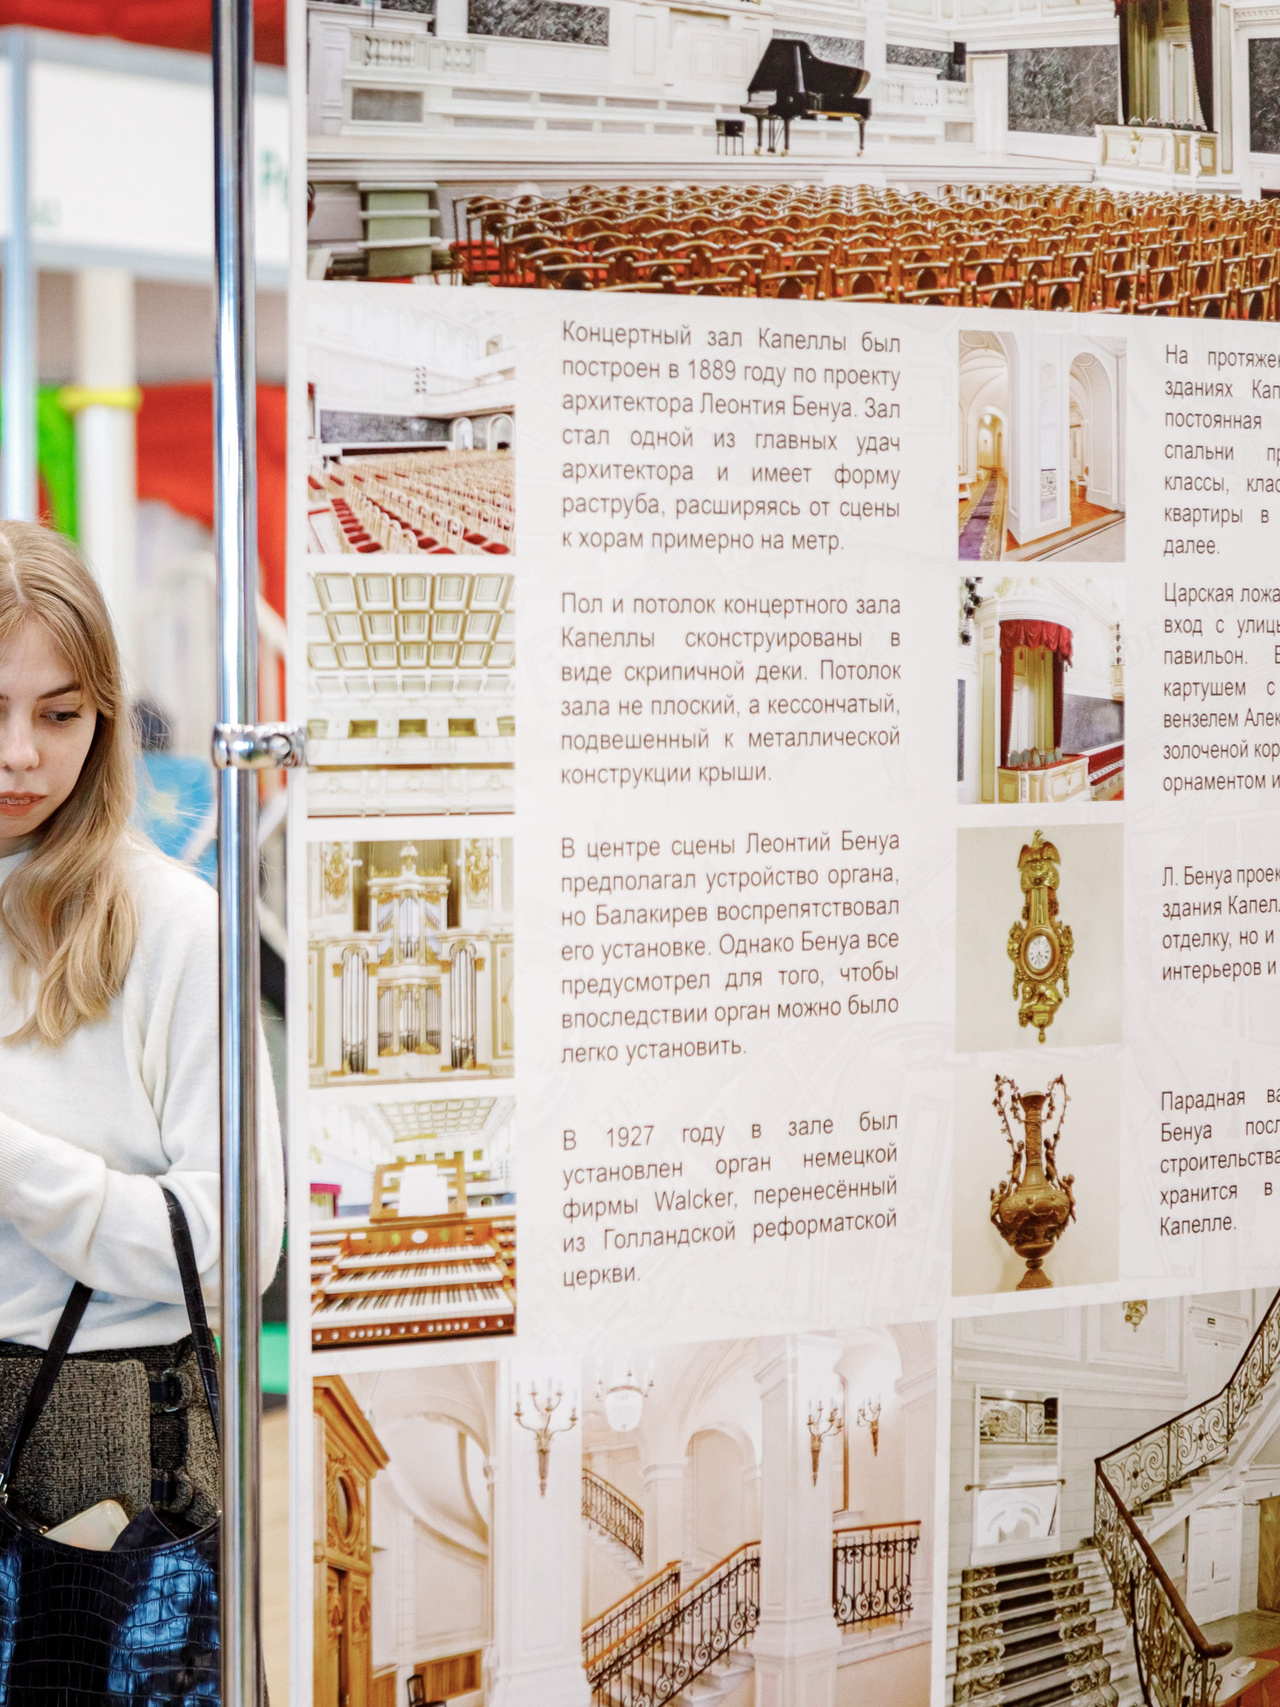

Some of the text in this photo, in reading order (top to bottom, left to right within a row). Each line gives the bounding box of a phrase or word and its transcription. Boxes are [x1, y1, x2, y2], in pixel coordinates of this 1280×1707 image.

[562, 319, 901, 353] Концертный зал Капеллы был
[1165, 343, 1280, 372] На протяже
[562, 358, 901, 392] построен в 1889 году по проекту
[1164, 378, 1280, 400] зданиях Кап
[561, 391, 901, 423] архитектора Леонтия Бенуа. Зал
[1164, 412, 1262, 430] постоянная
[562, 426, 900, 457] стал одной из главных удач
[1164, 443, 1234, 461] спальни
[562, 462, 901, 491] архитектора и имеет форму
[1164, 475, 1230, 495] классы,
[562, 492, 900, 521] раструба, расширяясь от сцены
[1164, 507, 1270, 528] квартиры в
[562, 531, 845, 556] к хорам примерно на метр.
[1162, 538, 1220, 558] далее.
[561, 591, 901, 620] Пол и потолок концертного зала
[1164, 582, 1280, 608] Царская ложа
[561, 626, 901, 654] Капеллы сконструированы в
[1164, 618, 1204, 638] вход
[1215, 618, 1225, 634] с
[1163, 649, 1248, 666] павильон.
[561, 658, 902, 687] виде скрипичной деки. Потолок
[1163, 680, 1276, 702] картушем с
[561, 692, 900, 718] зала не плоский, а кессончатый,
[1163, 712, 1239, 729] вензелем
[561, 725, 900, 754] подвешенный к металлической
[1162, 738, 1280, 763] золоченой кор
[561, 765, 772, 790] конструкции крыши.
[1162, 773, 1280, 797] орнаментом и
[561, 829, 900, 862] В центре сцены Леонтий Бенуа
[561, 865, 899, 898] предполагал устройство органа,
[1161, 866, 1179, 887] Л.
[1183, 865, 1233, 890] Бенуа
[561, 899, 900, 929] но Балакирев воспрепятствовал
[1162, 894, 1280, 921] здания Капел
[561, 930, 900, 966] его установке. Однако Бенуа все
[1161, 929, 1275, 953] отделку, но и
[561, 959, 899, 1000] предусмотрел для того, чтобы
[1162, 960, 1277, 984] интерьеров и
[561, 993, 899, 1030] впоследствии орган можно было
[560, 1039, 747, 1067] легко установить.
[1160, 1090, 1246, 1115] Парадная
[563, 1110, 898, 1151] В 1927 году в зале был
[1160, 1121, 1213, 1146] Бенуа
[562, 1142, 898, 1191] установлен орган немецкой
[562, 1174, 897, 1224] фирмы Walcker, перенесённый
[1159, 1181, 1274, 1210] хранится в
[563, 1207, 897, 1253] из Голландской реформатской
[1159, 1215, 1237, 1237] Капелле.
[563, 1266, 641, 1291] церкви.
